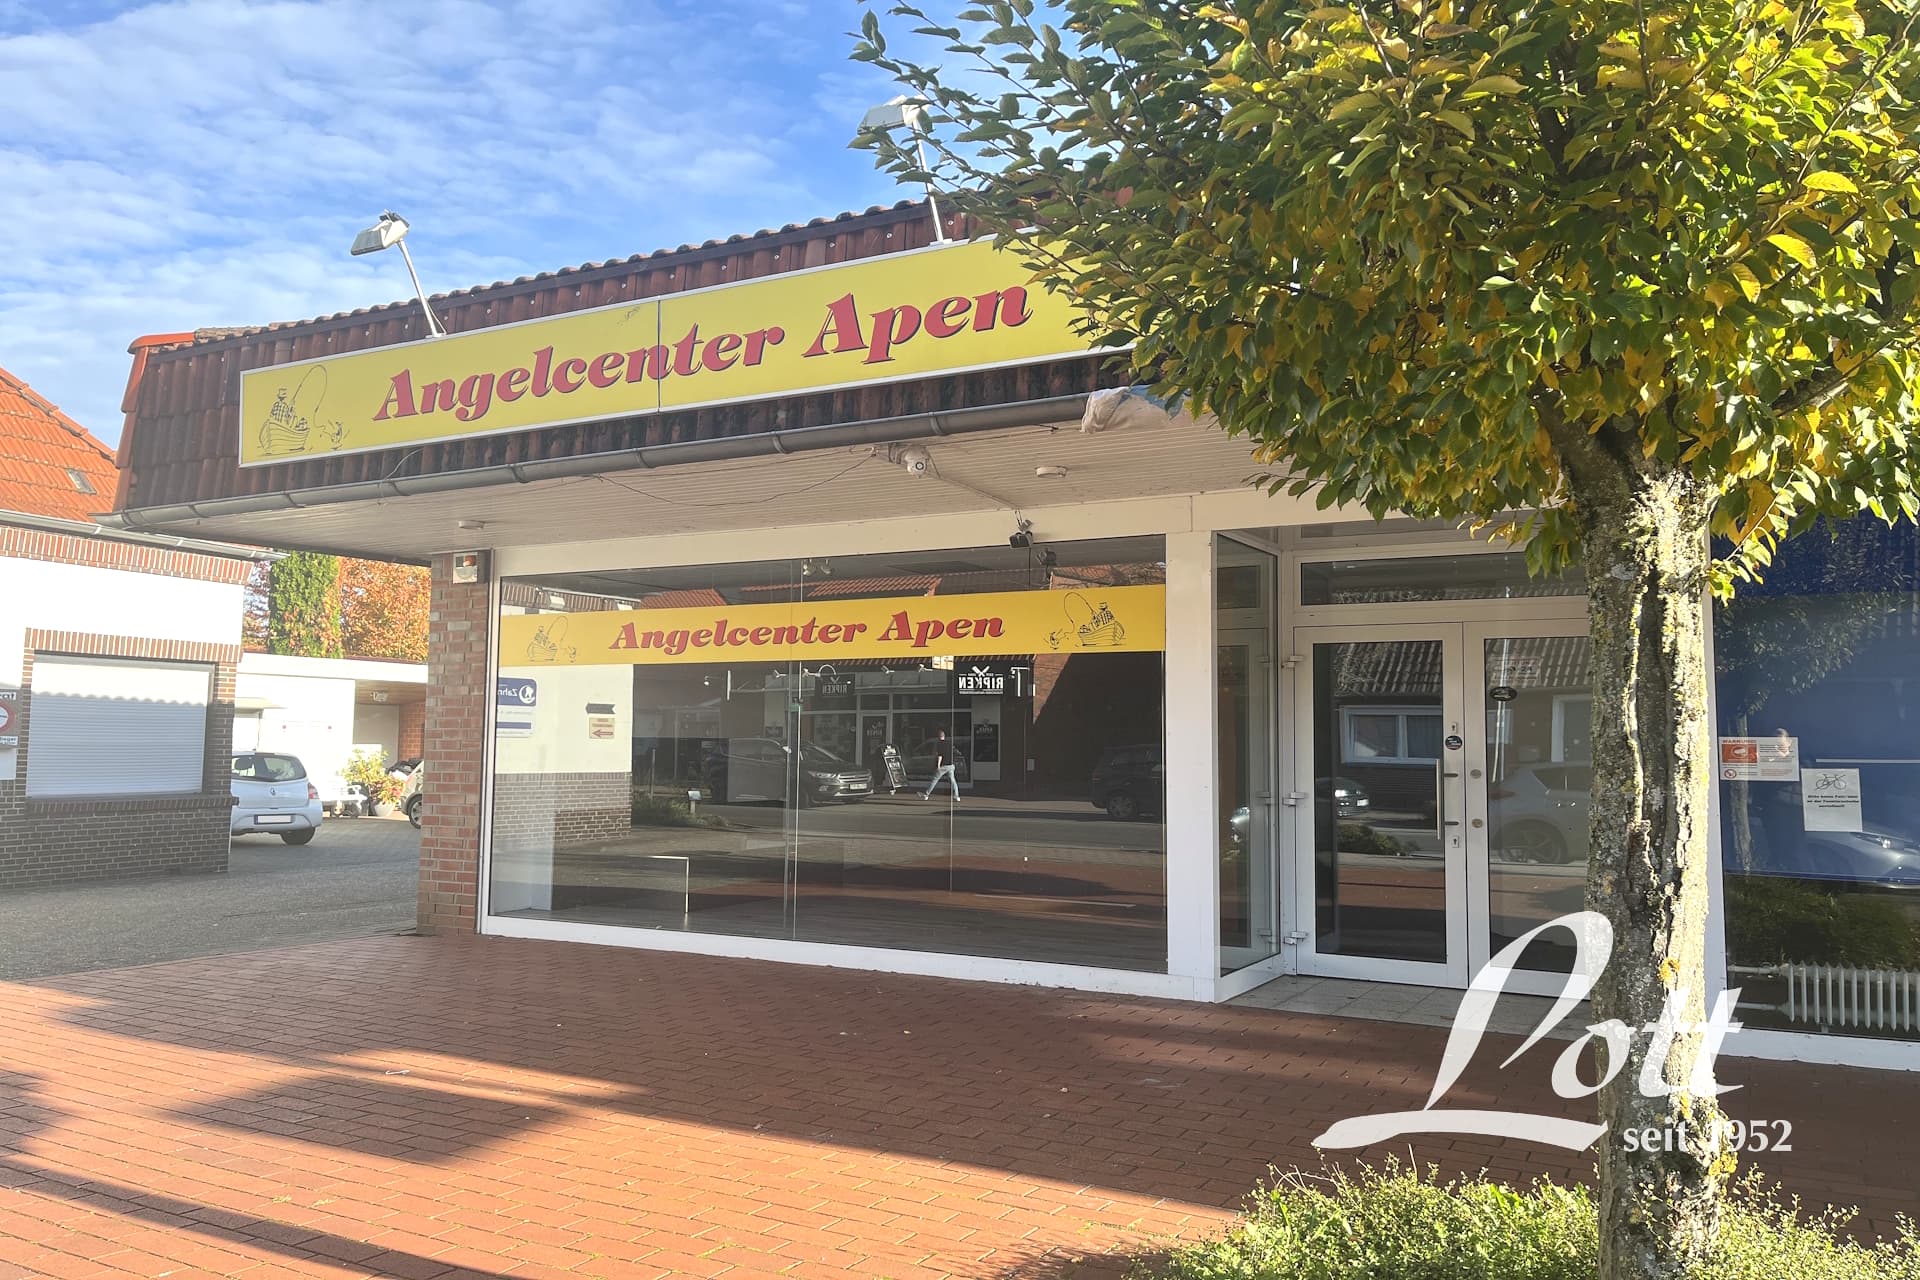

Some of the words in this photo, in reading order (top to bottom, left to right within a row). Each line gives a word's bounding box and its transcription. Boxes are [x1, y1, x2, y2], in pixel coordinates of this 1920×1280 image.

[372, 323, 785, 422] Angelcenter
[804, 286, 1034, 365] Apen
[608, 616, 867, 655] Angelcenter
[876, 610, 1005, 648] Apen
